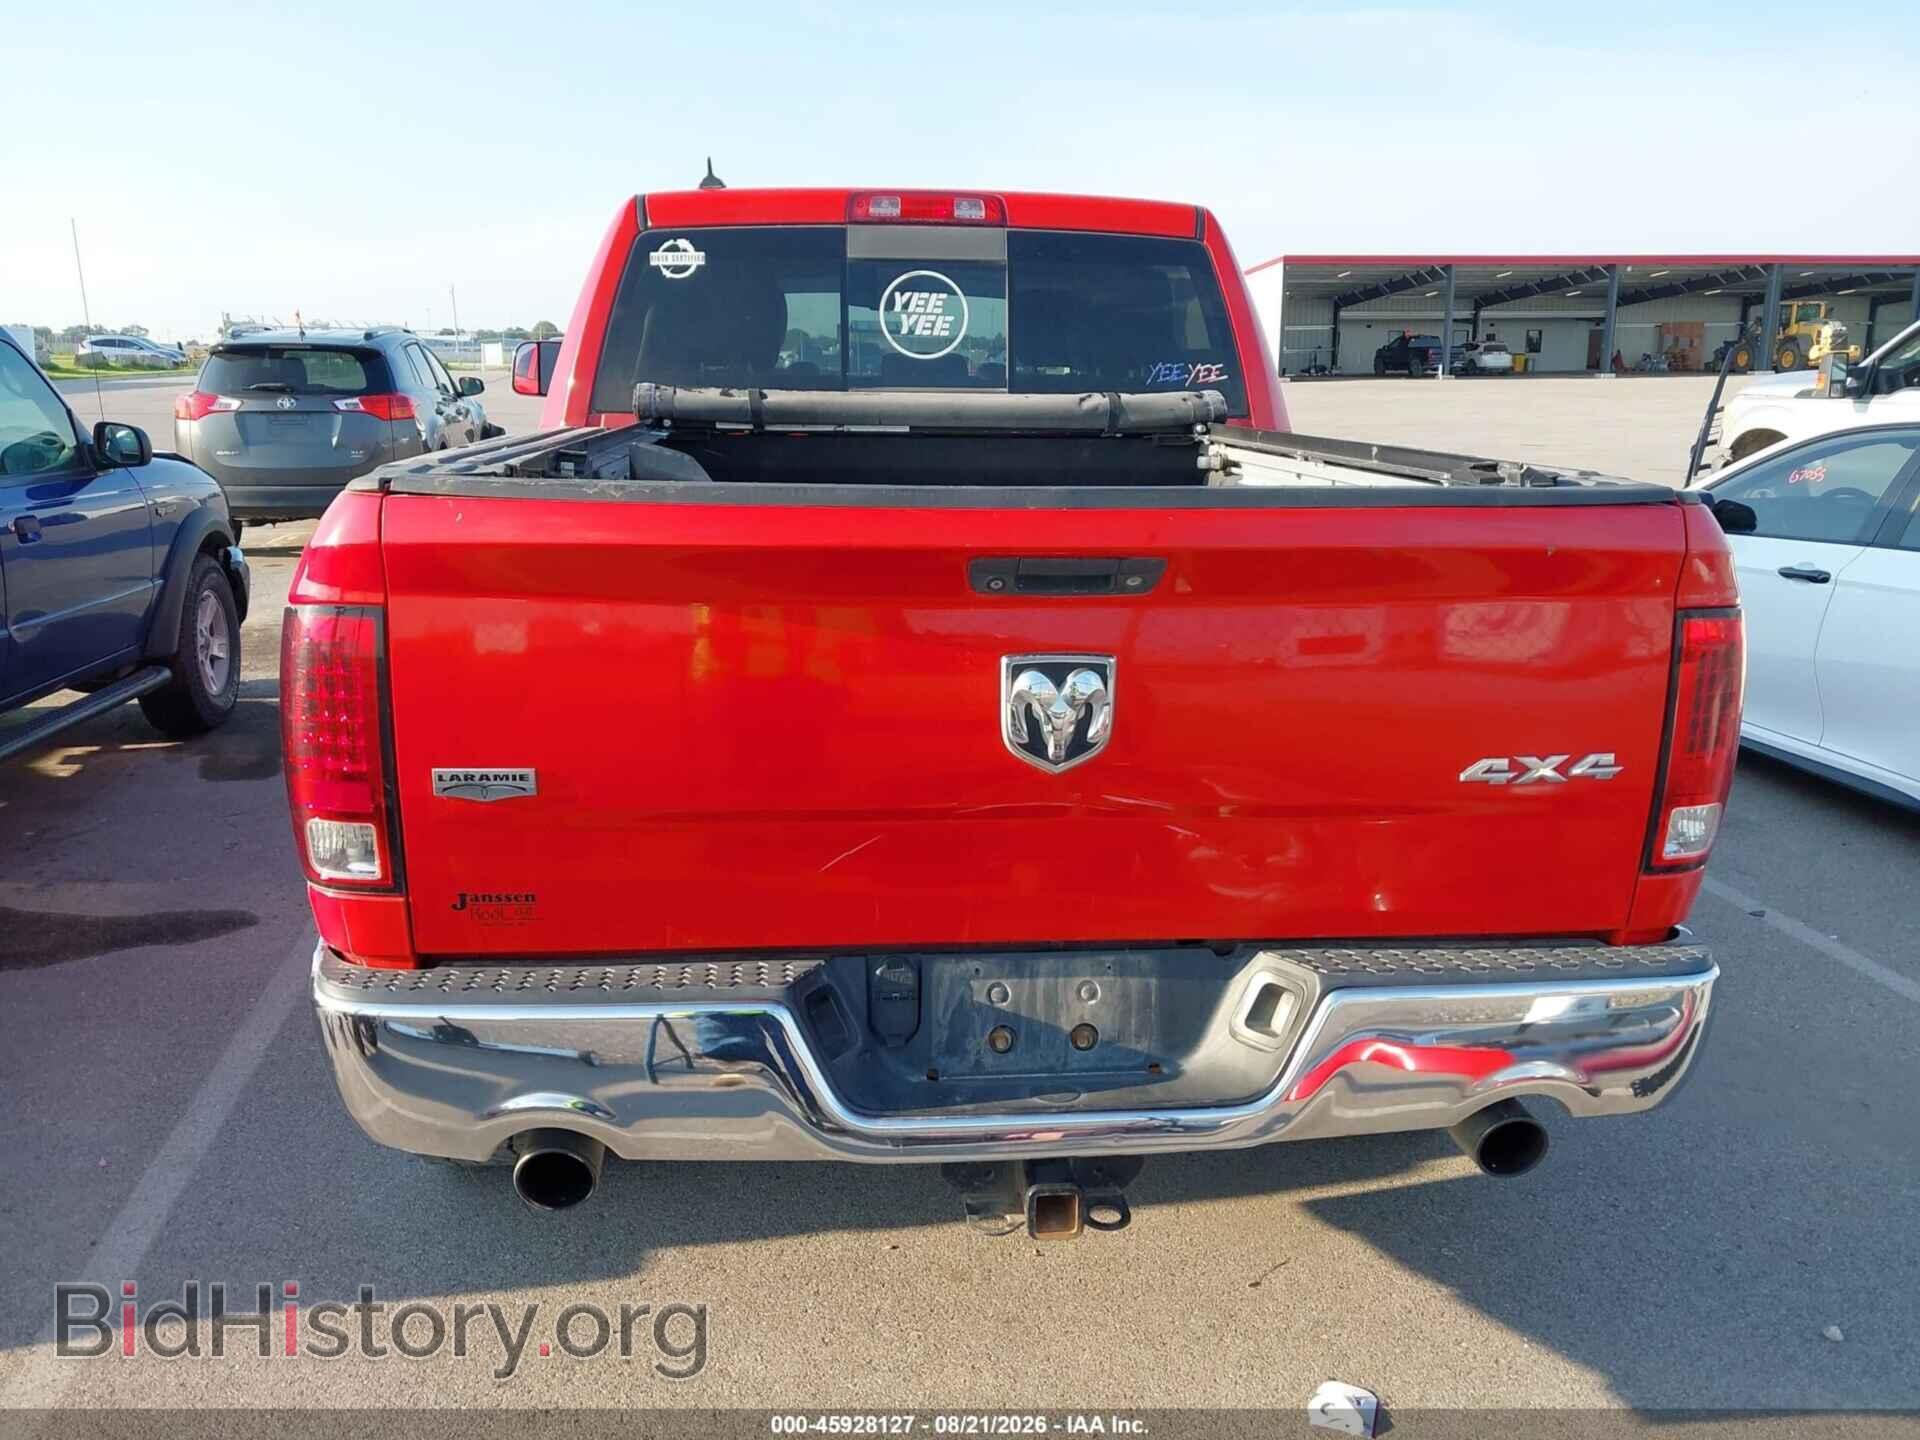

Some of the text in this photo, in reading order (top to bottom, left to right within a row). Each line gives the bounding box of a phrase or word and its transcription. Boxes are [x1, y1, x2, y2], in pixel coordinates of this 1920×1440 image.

[894, 291, 948, 313] YEE
[900, 313, 955, 337] YEE
[1146, 362, 1229, 388] YEE YEE
[436, 773, 530, 783] LARAMIE
[451, 892, 536, 911] Janssen
